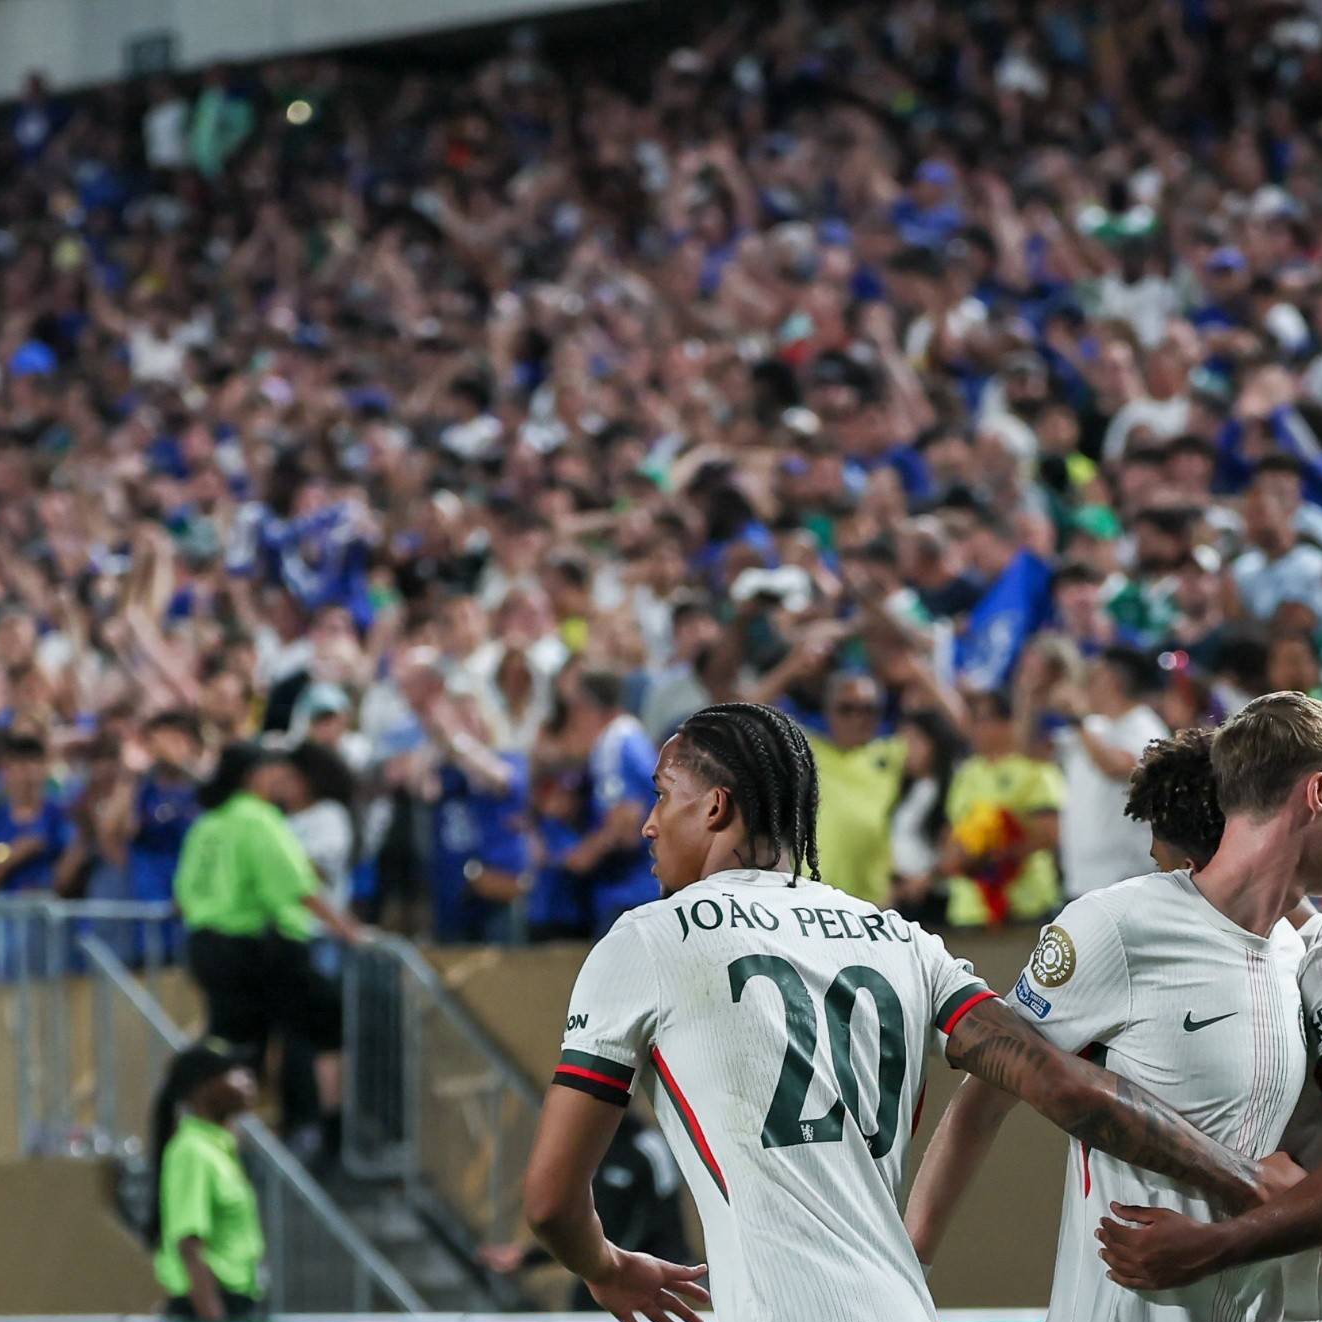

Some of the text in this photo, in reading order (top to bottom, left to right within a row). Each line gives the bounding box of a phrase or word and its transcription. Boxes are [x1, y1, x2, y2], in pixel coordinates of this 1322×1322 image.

[674, 893, 911, 943] JOÃO PEDRO
[1033, 963, 1047, 984] FIFA
[566, 1013, 589, 1031] ON
[728, 953, 906, 1159] 20
